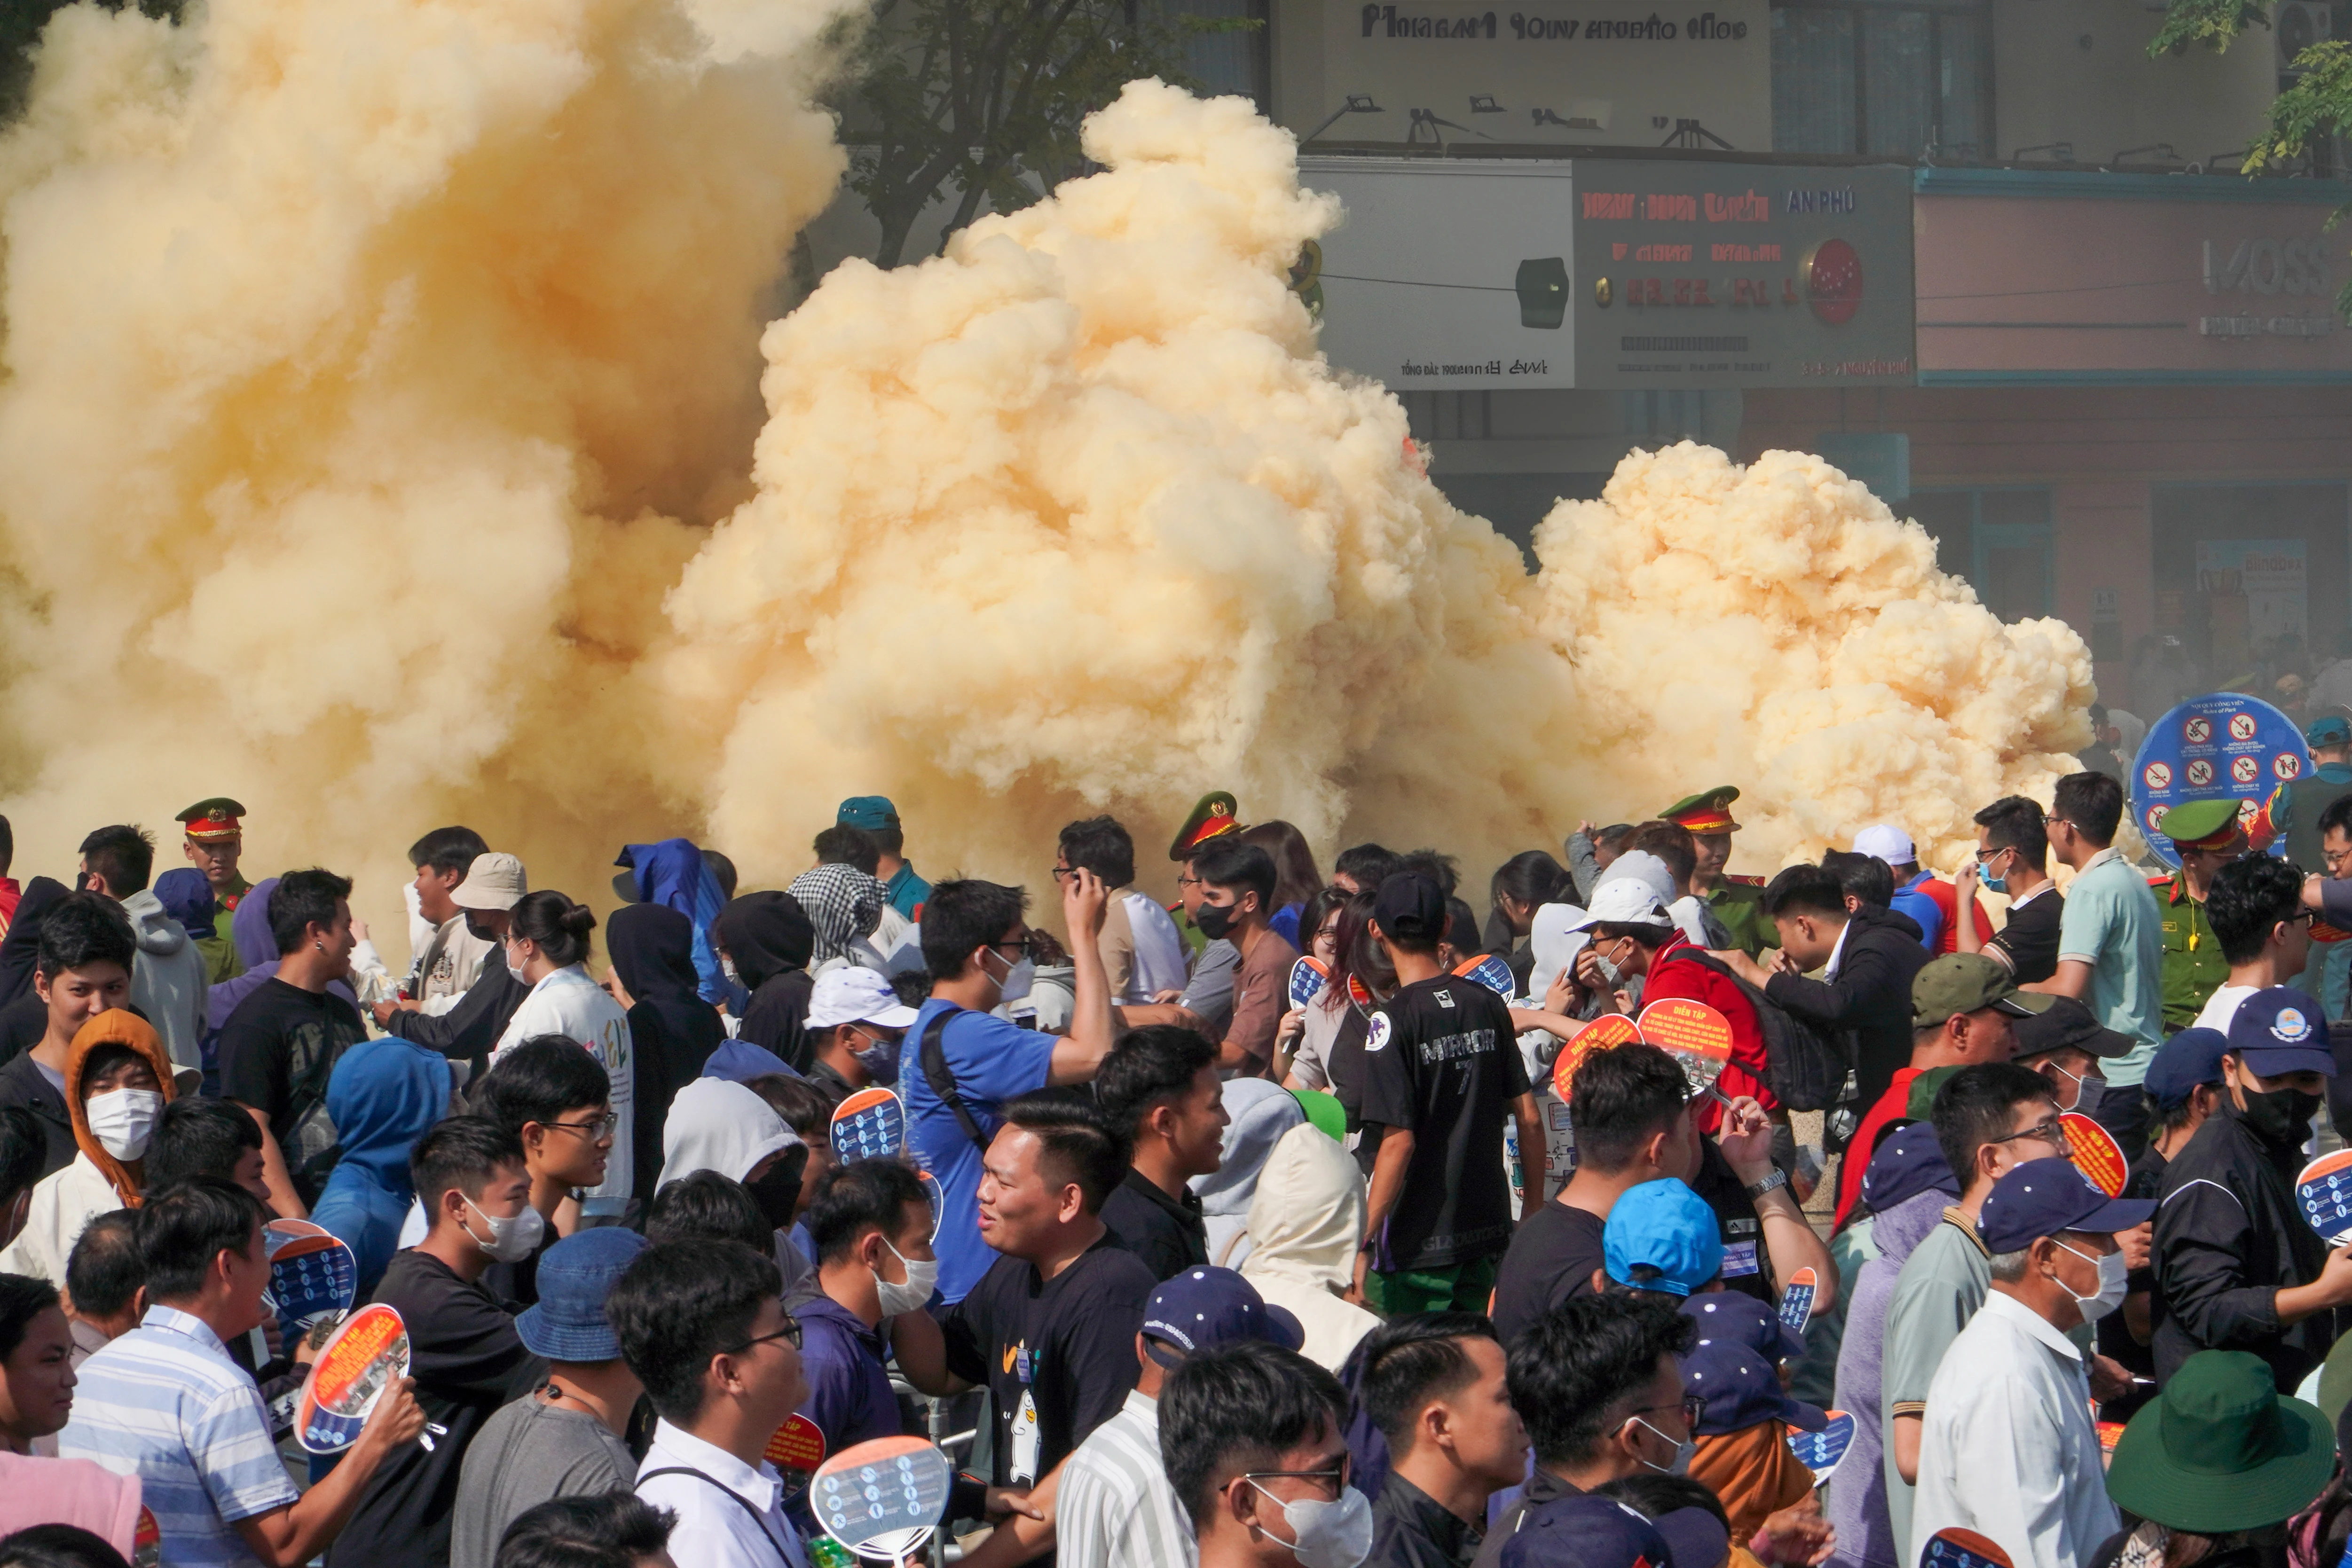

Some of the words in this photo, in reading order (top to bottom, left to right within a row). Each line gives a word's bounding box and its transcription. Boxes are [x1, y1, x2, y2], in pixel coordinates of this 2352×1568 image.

[1787, 190, 1812, 213] AN
[1819, 185, 1856, 213] PHÚ
[1673, 1005, 1691, 1017] DIỄN
[1692, 1009, 1707, 1021] TẬP
[1419, 1029, 1495, 1065] MIRROR
[1455, 1059, 1473, 1094] 7
